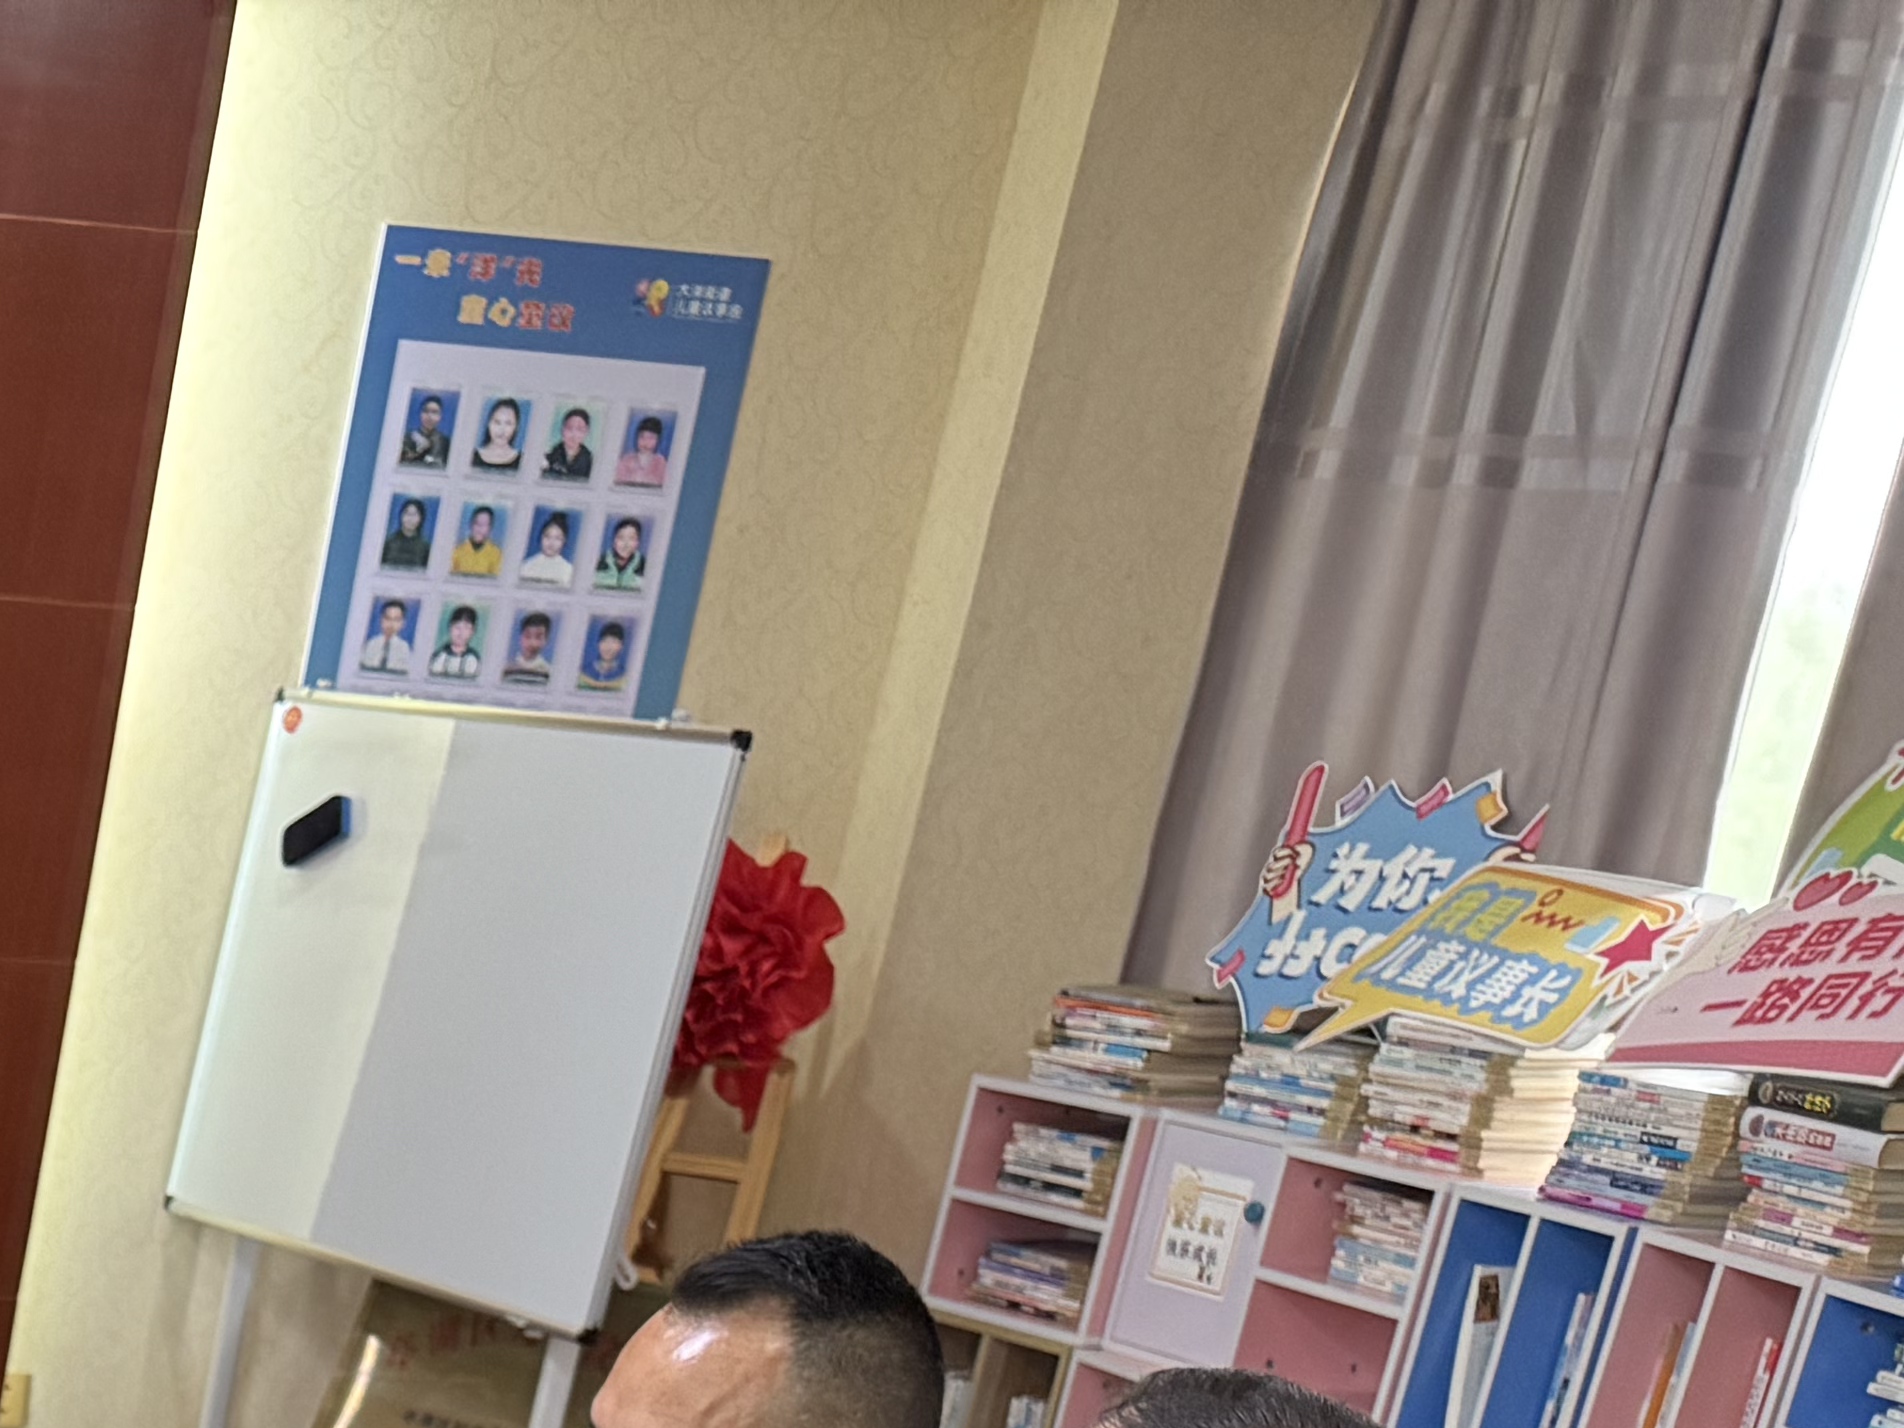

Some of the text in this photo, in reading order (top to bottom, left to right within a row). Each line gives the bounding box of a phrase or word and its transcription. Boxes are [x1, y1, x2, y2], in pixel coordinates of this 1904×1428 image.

[1310, 840, 1457, 914] 为你
[1364, 933, 1572, 1022] 儿童议事长
[1700, 968, 1904, 1028] 一路同行
